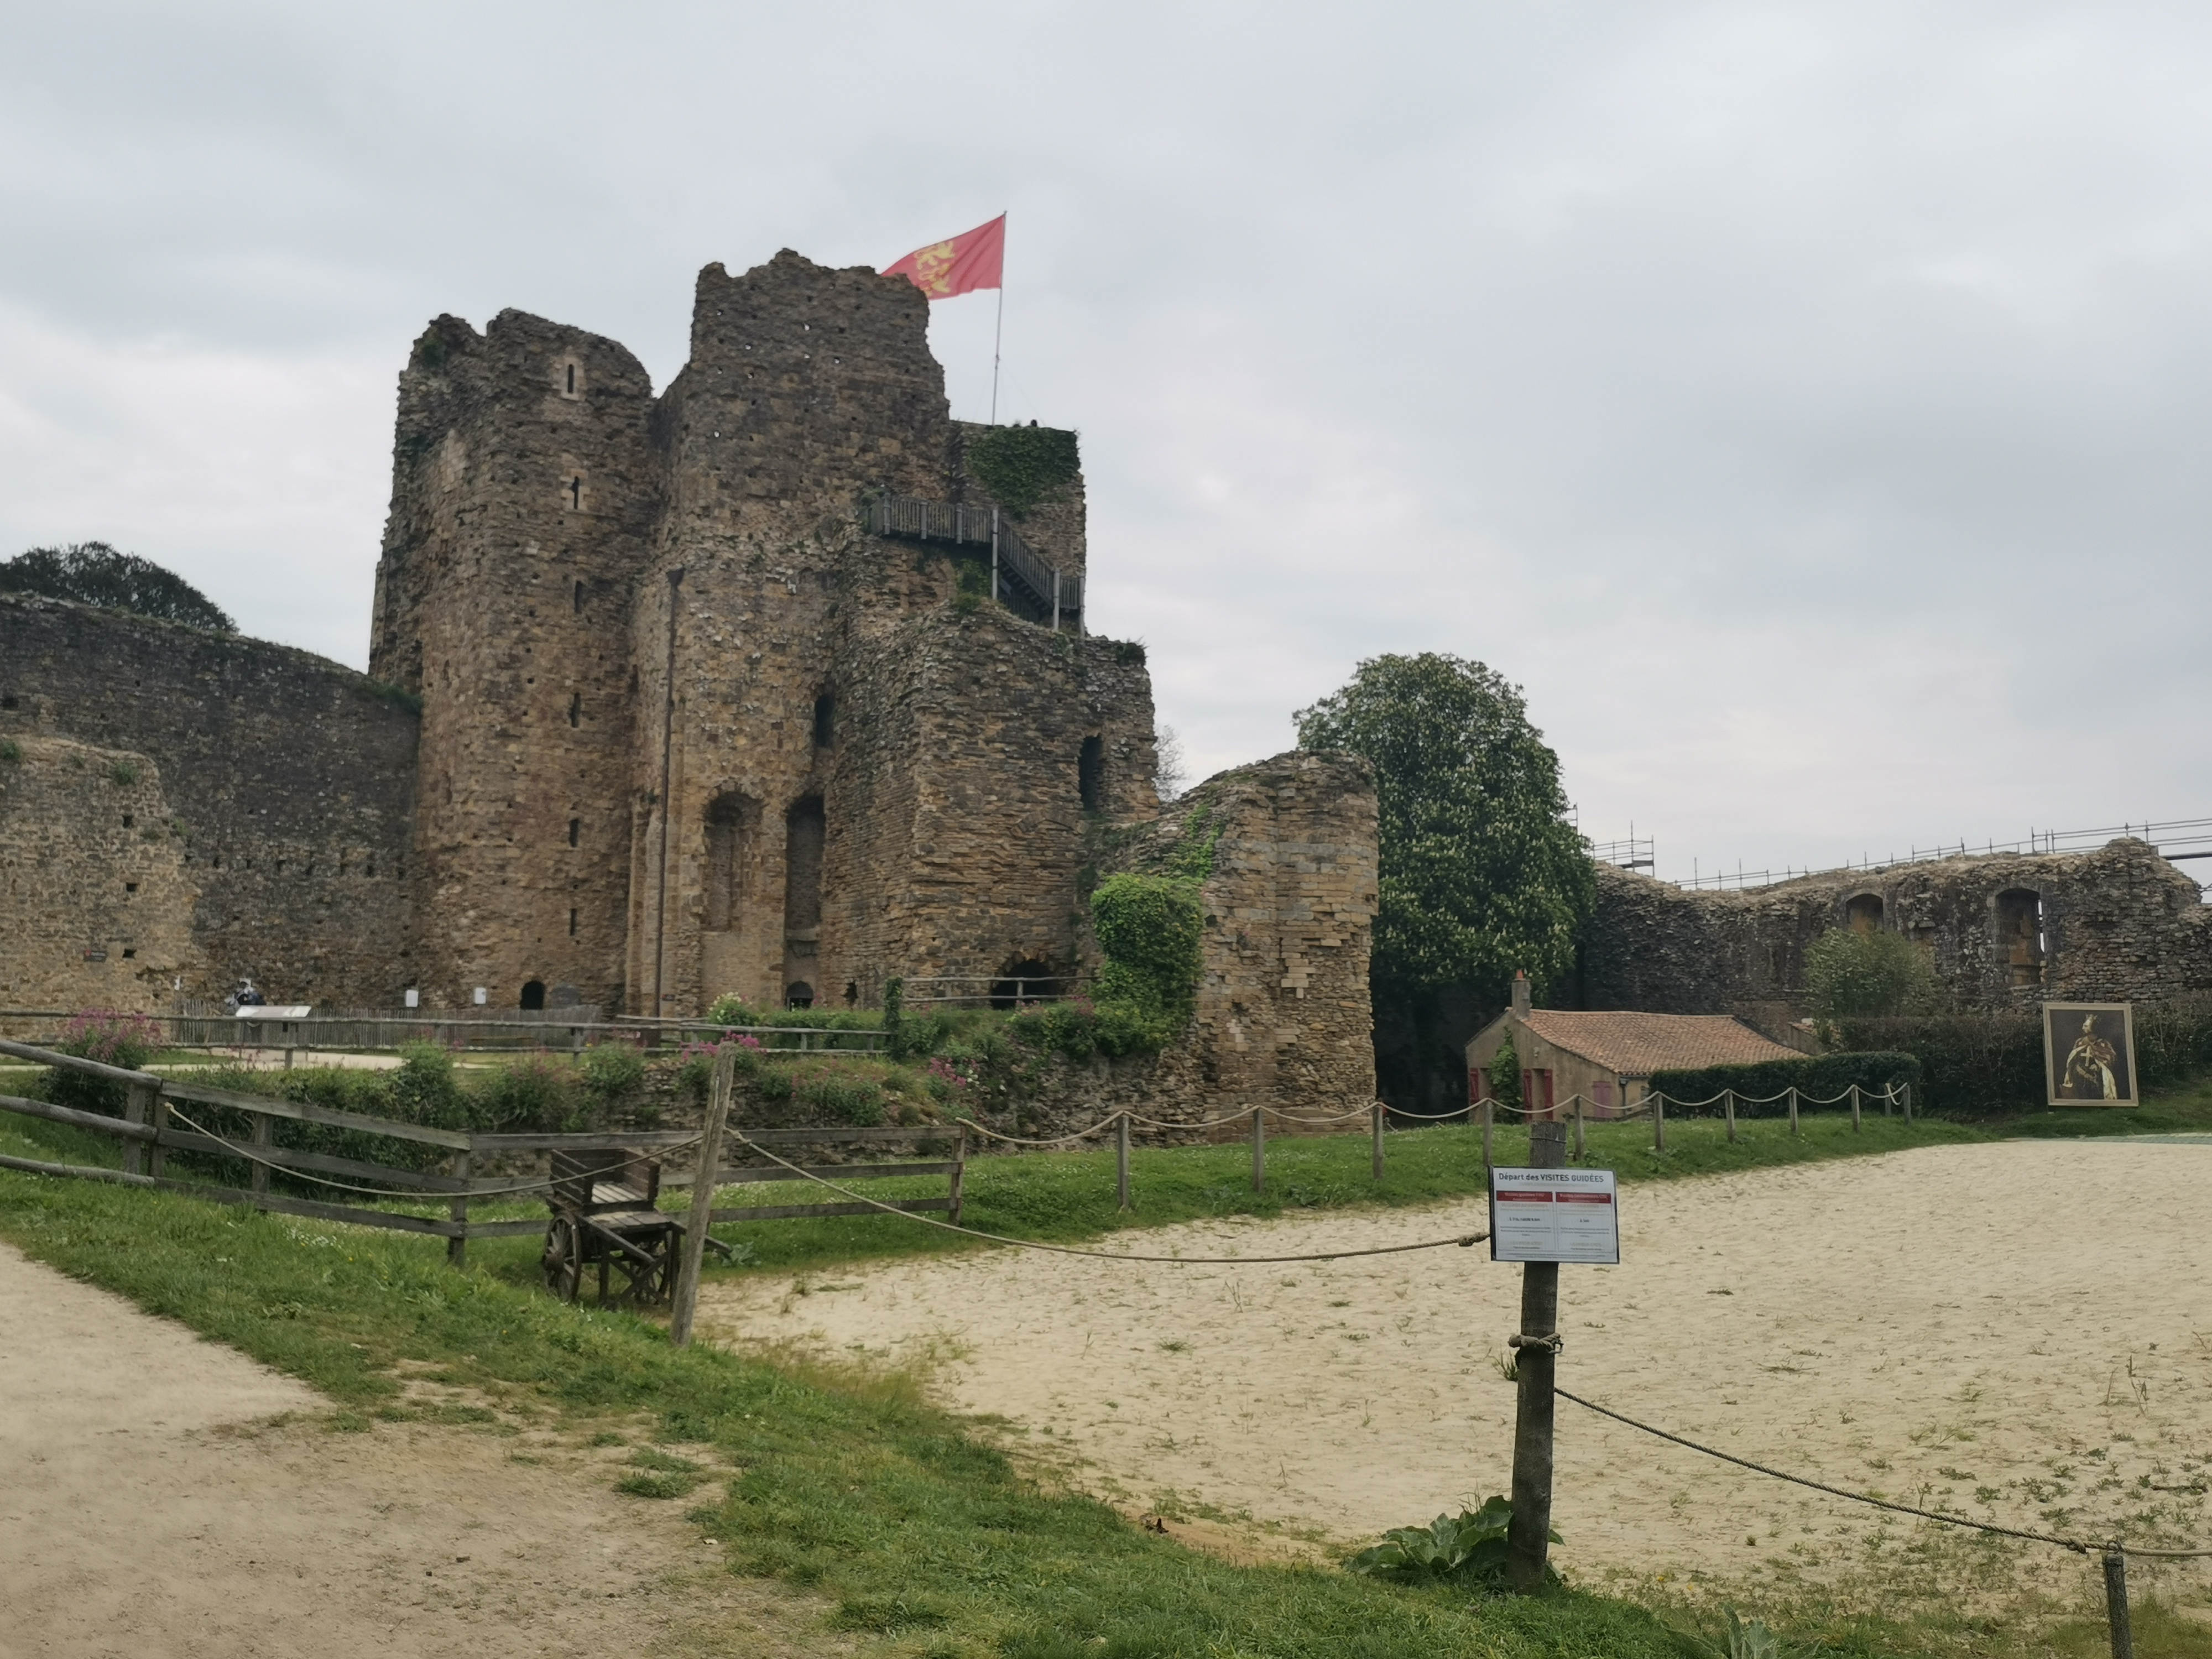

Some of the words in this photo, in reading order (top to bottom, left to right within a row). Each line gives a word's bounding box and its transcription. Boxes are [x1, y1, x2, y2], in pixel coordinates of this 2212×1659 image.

[1499, 1172, 1525, 1181] Départ
[1540, 1173, 1569, 1182] VISITES
[1571, 1173, 1604, 1182] GUIDÉES
